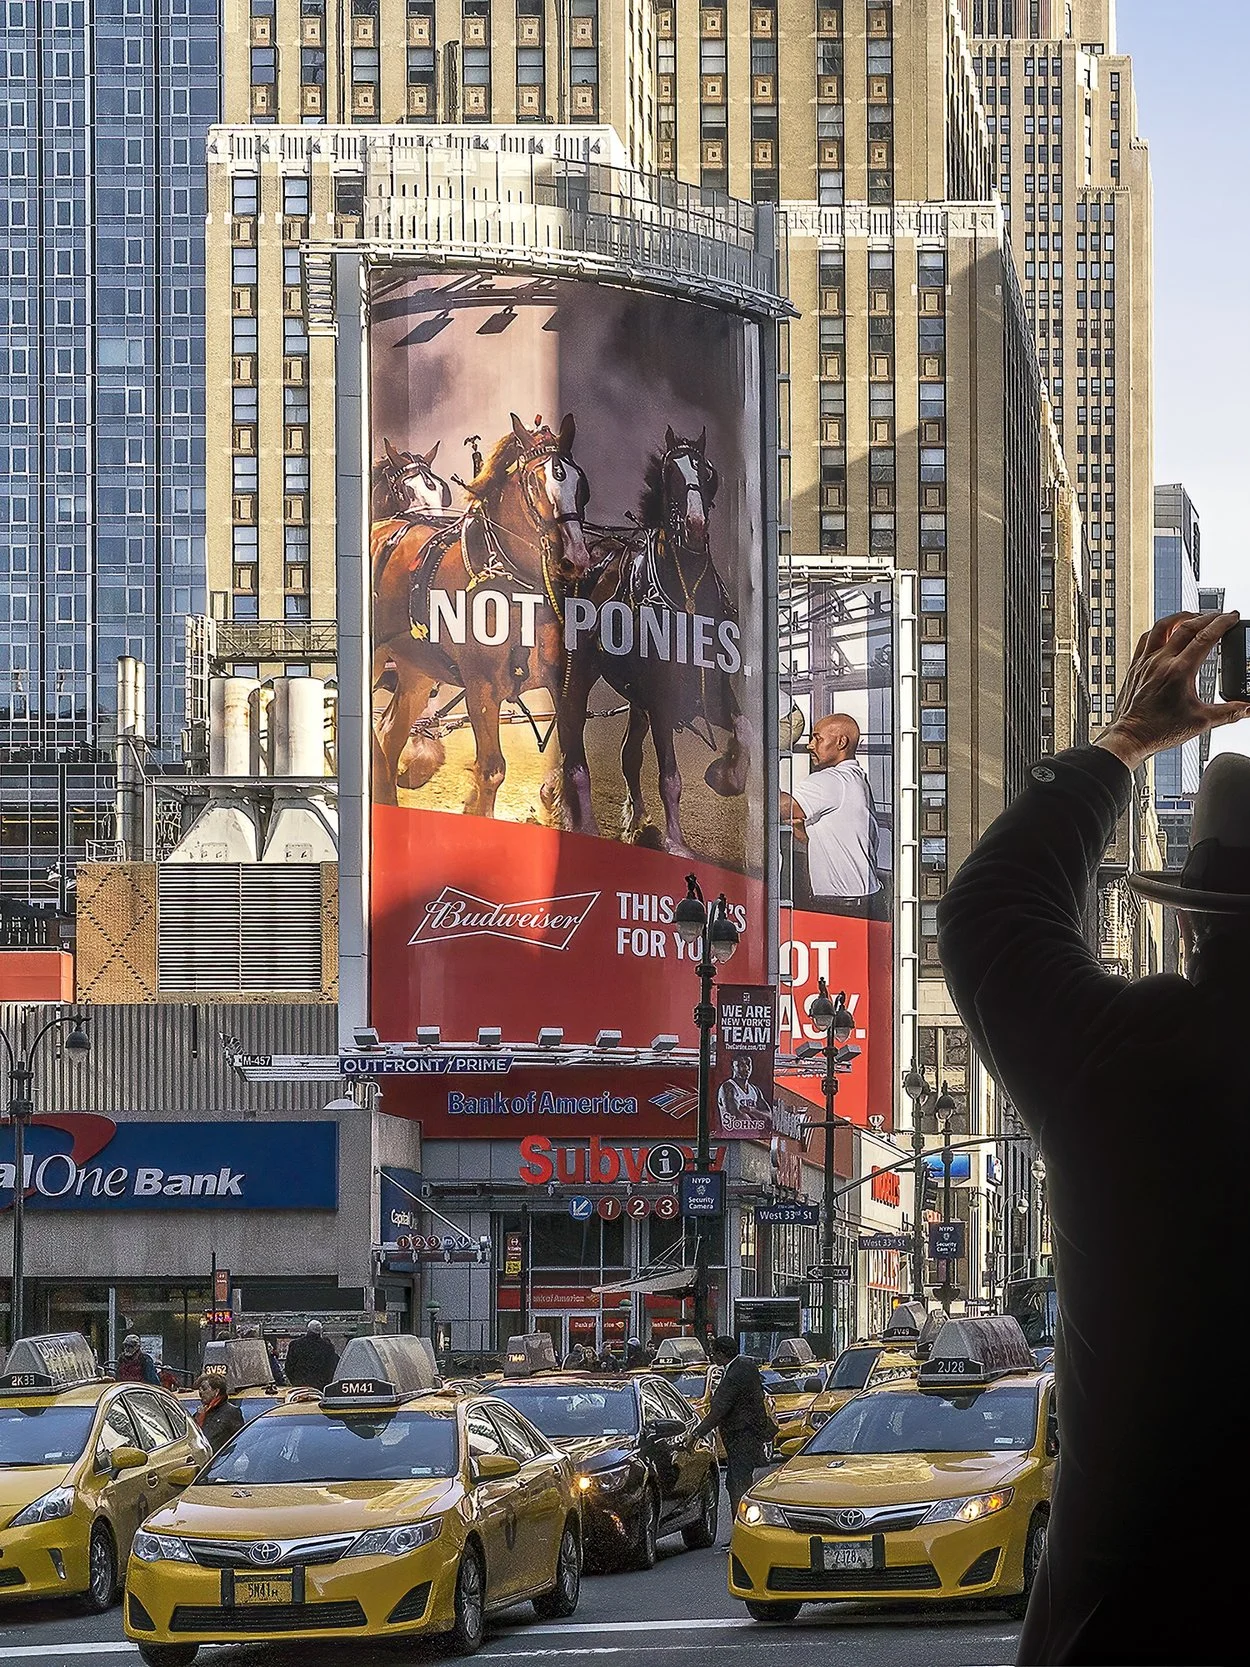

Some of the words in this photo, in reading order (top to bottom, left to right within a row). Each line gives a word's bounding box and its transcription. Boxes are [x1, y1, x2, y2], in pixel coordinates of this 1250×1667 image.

[428, 588, 544, 648] NOT
[563, 596, 752, 677] PONIES.
[425, 900, 582, 930] Budweiser
[616, 891, 674, 924] THIS
[617, 927, 666, 958] FOR
[672, 931, 720, 963] YO
[722, 1004, 742, 1018] WE
[745, 1005, 771, 1019] ARE
[721, 1017, 740, 1026] NEW
[741, 1018, 771, 1027] YORK'S
[721, 1026, 771, 1043] TEAM
[243, 1055, 271, 1067] M-457
[343, 1058, 445, 1073] OUTFRONT
[456, 1058, 508, 1072] PRIME
[447, 1090, 509, 1115] Bank
[509, 1090, 537, 1115] of
[538, 1090, 638, 1115] America
[133, 1168, 245, 1197] Bank
[605, 1200, 613, 1216] 1
[632, 1200, 645, 1216] 2
[661, 1199, 673, 1216] 3
[688, 1196, 715, 1204] Security
[759, 1210, 782, 1220] West
[803, 1210, 812, 1220] St
[862, 1239, 882, 1247] West
[206, 1364, 227, 1376] 3V52
[937, 1360, 965, 1374] 2J28
[341, 1382, 375, 1394] 5M41
